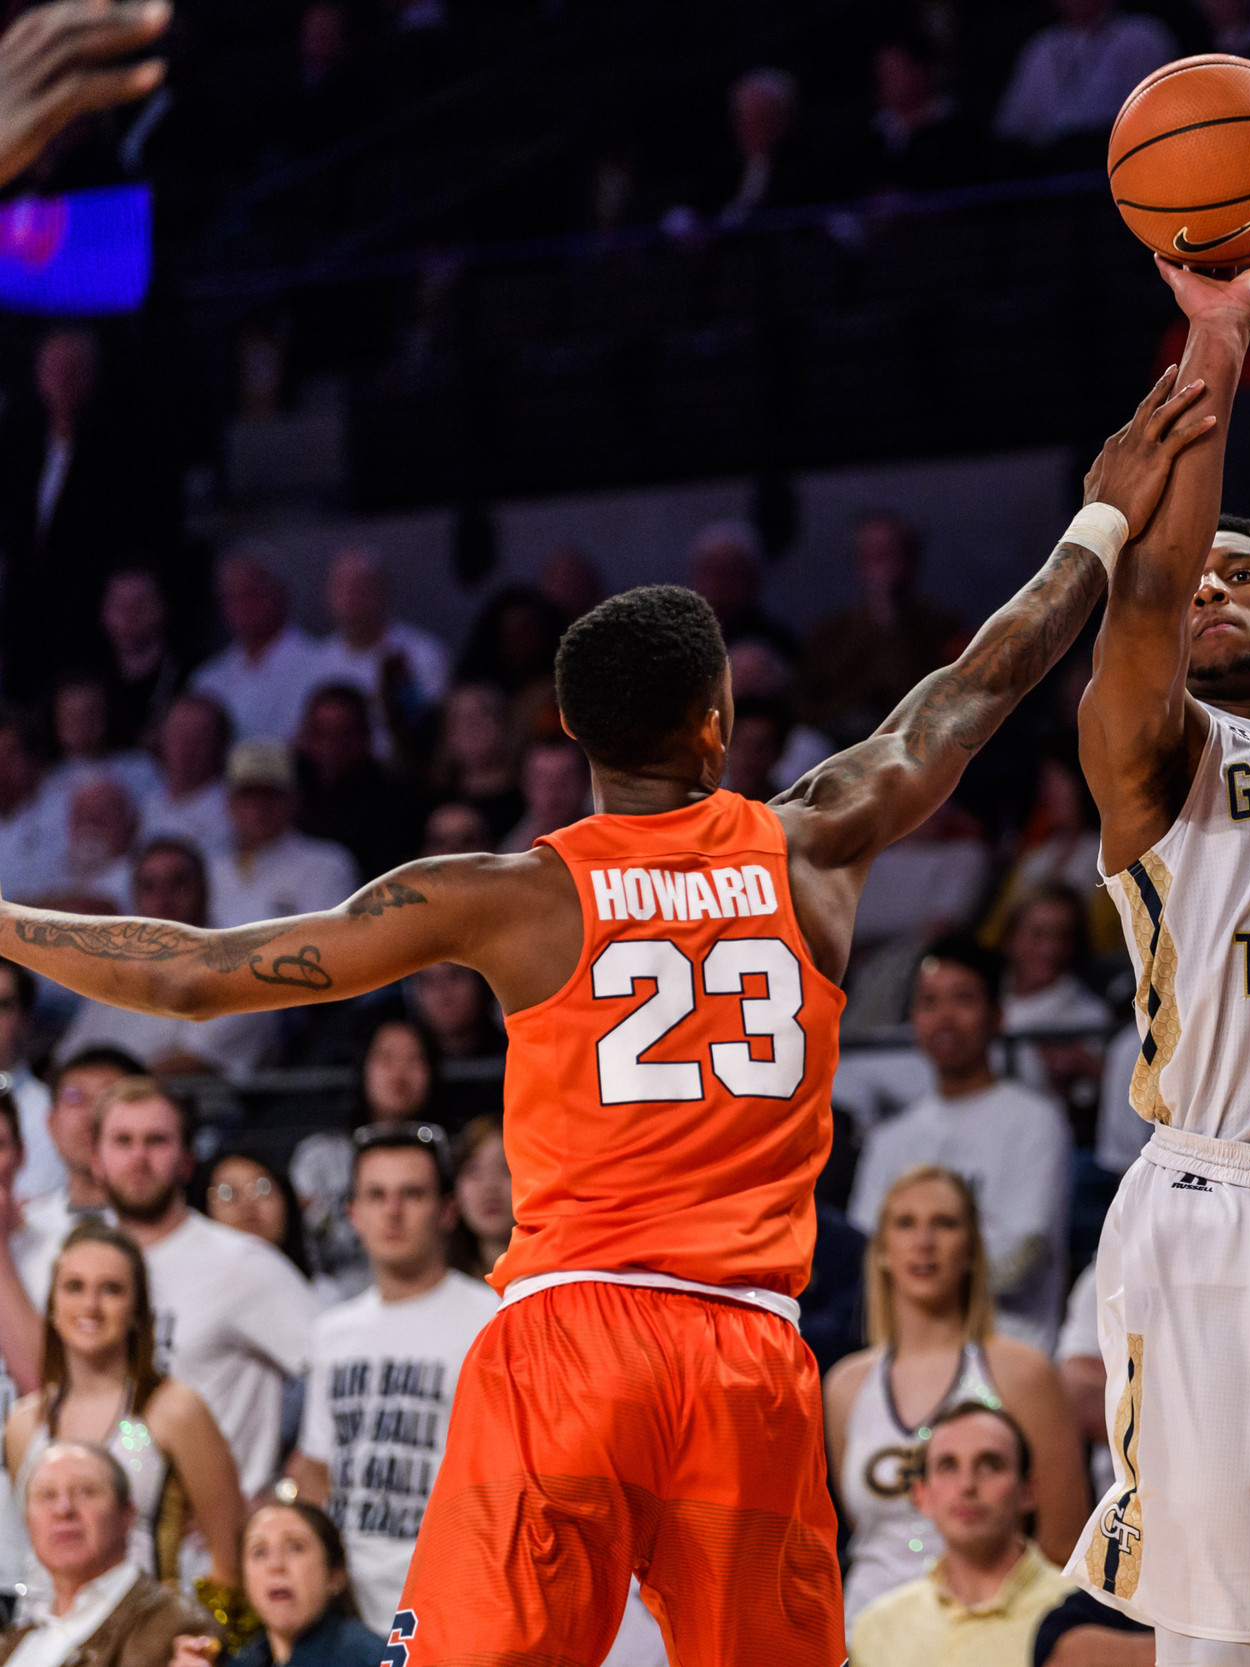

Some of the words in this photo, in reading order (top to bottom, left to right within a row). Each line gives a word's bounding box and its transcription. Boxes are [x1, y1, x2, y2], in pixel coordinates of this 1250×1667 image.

[590, 865, 779, 922] HOWARD
[590, 937, 806, 1107] 23
[1171, 1182, 1214, 1193] RUSSELL
[379, 1359, 444, 1401] BALL
[1101, 1502, 1140, 1554] GT
